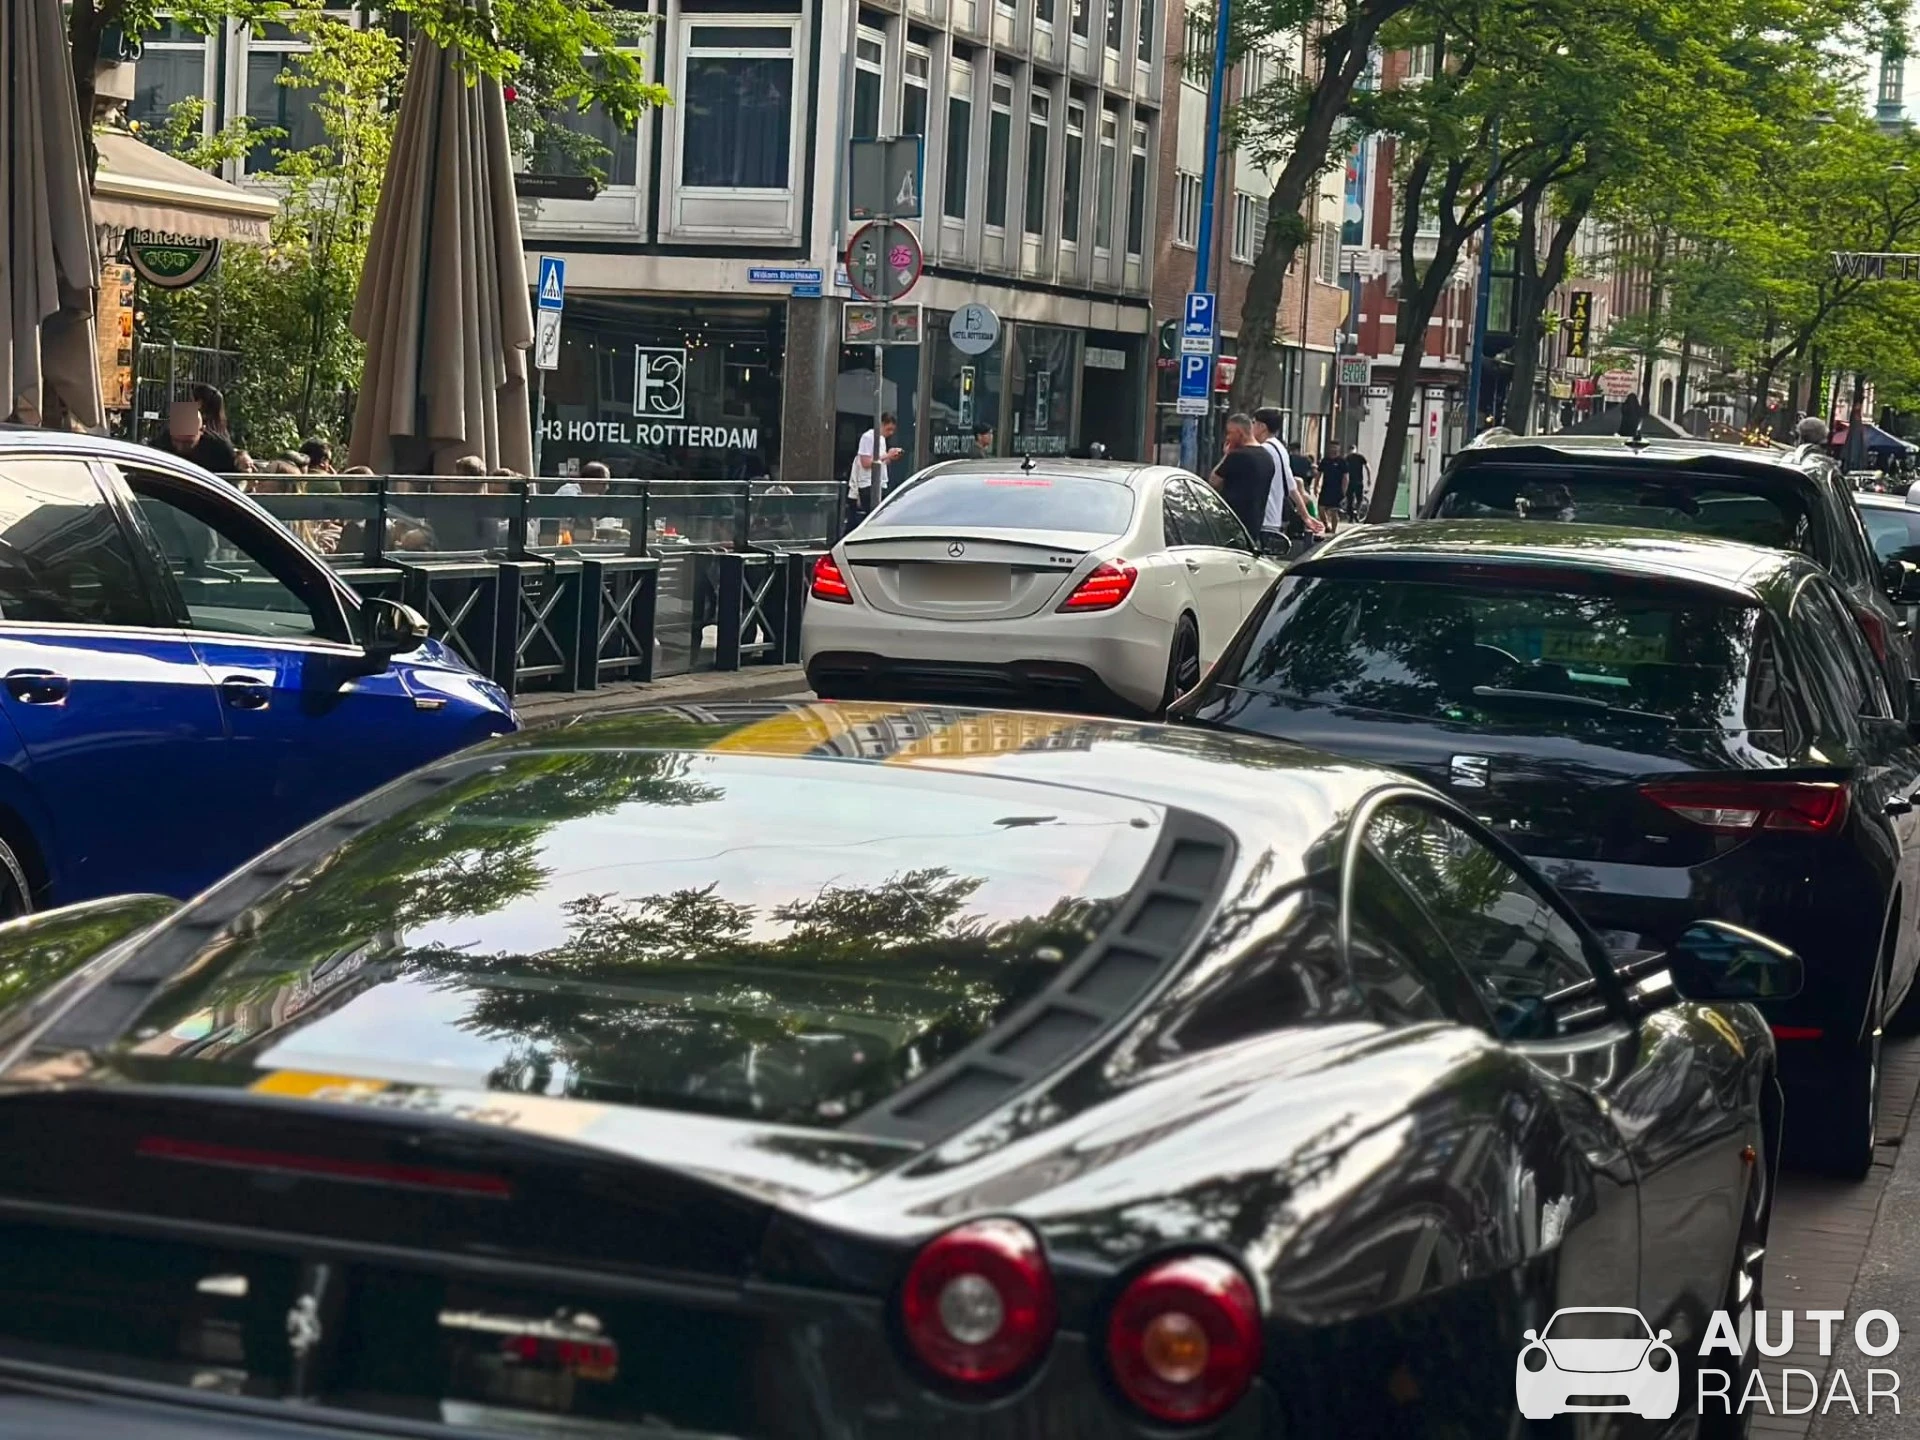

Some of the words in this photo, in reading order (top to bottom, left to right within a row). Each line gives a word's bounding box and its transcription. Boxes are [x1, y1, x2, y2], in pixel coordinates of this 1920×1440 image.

[1191, 296, 1208, 318] P
[1571, 294, 1587, 356] JAFFA
[1186, 356, 1204, 379] P
[541, 420, 562, 441] H3
[568, 421, 631, 444] HOTEL
[636, 423, 758, 449] ROTTERDAM
